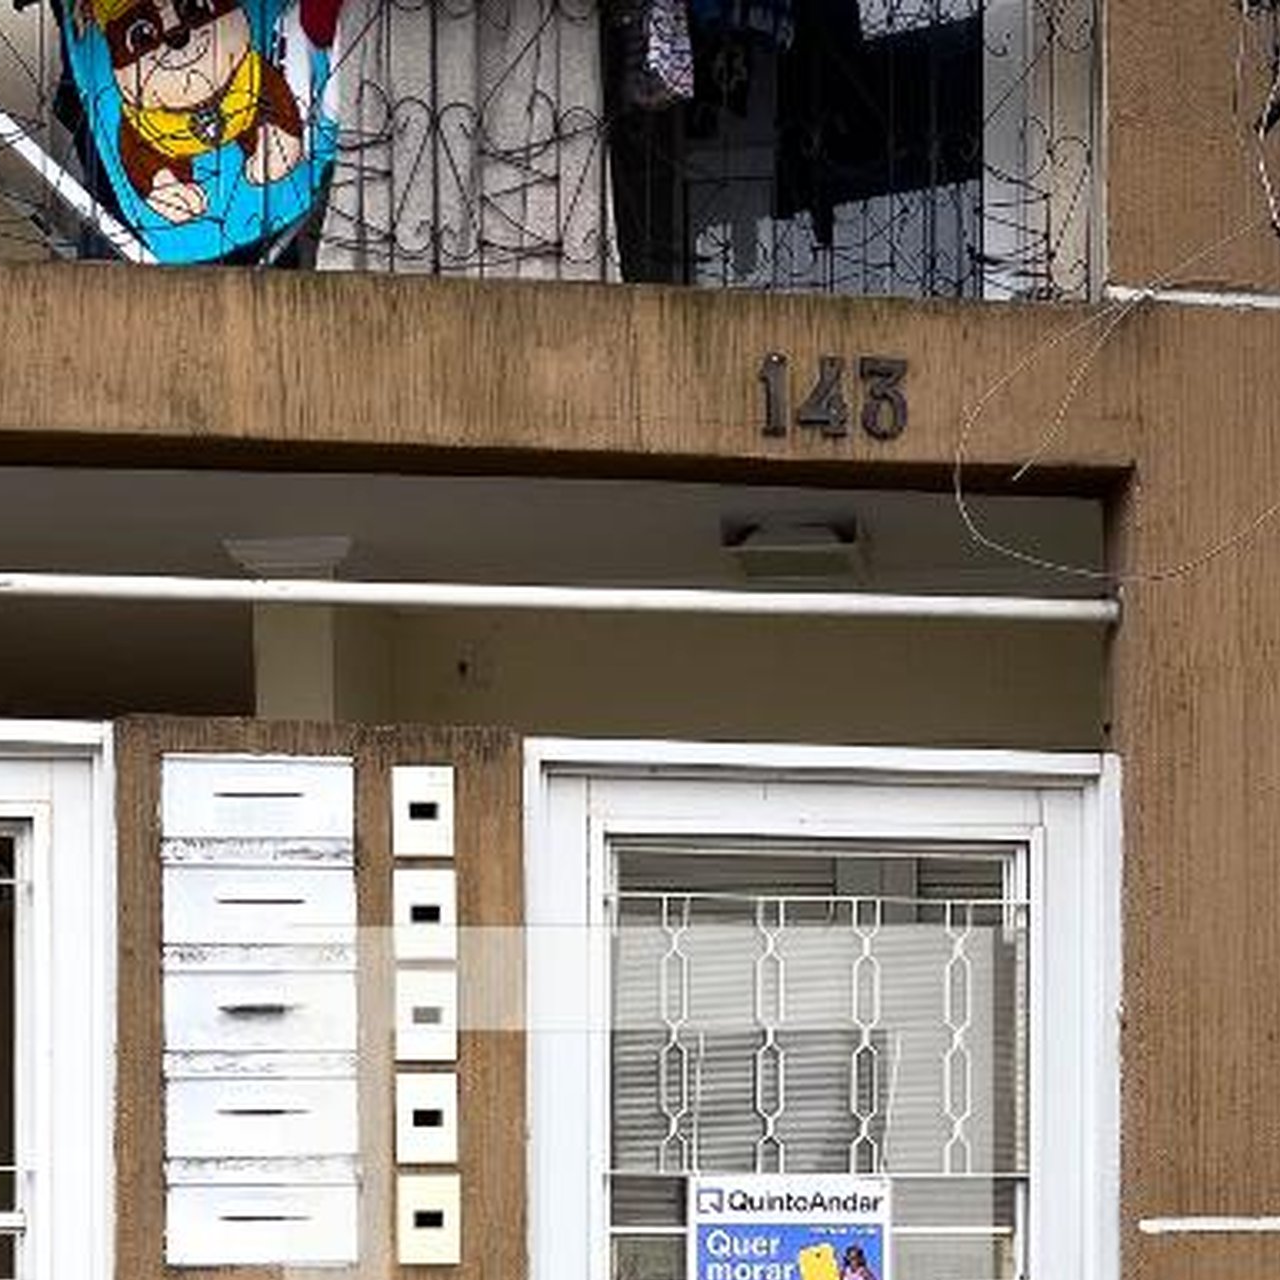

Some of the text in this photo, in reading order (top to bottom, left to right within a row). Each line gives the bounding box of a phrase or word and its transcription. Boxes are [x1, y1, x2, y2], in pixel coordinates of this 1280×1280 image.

[758, 351, 909, 440] 143
[727, 1189, 884, 1214] QuintoAndar
[705, 1229, 781, 1258] Quer
